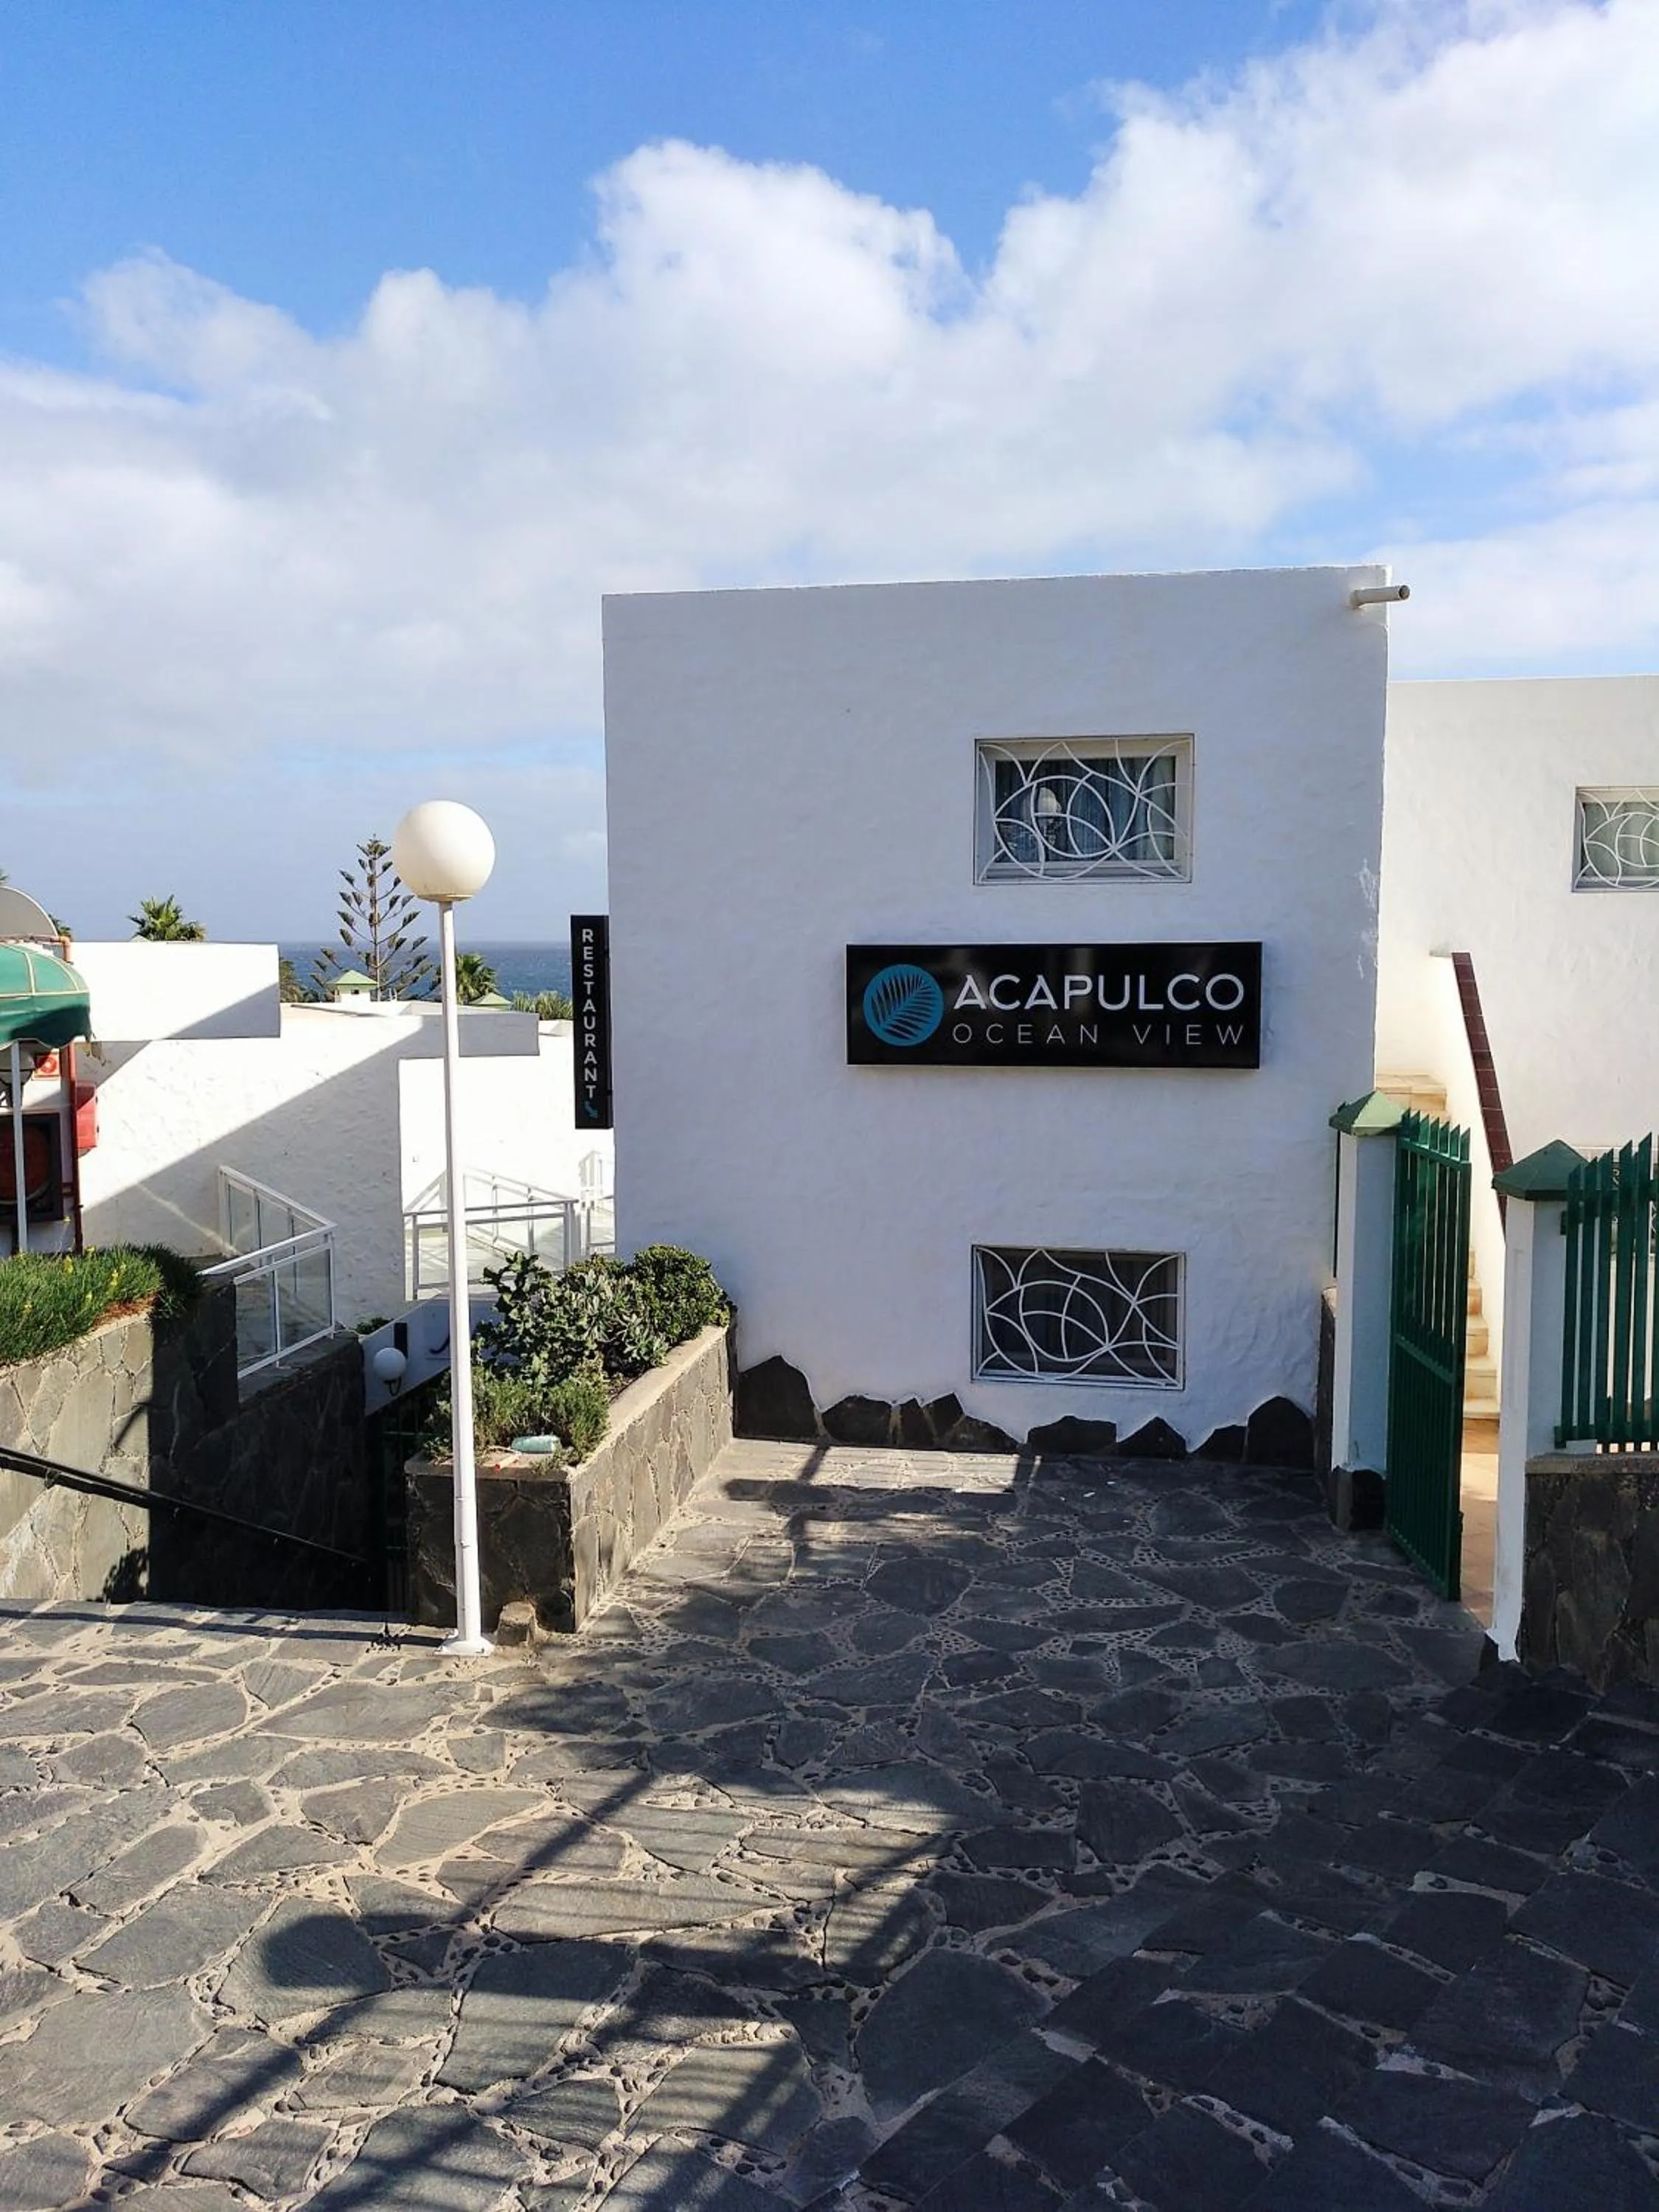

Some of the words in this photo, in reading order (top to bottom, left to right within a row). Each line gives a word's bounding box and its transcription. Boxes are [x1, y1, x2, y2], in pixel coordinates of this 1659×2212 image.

[953, 973, 1245, 1011] ACAPULCO
[582, 928, 598, 1098] RESTAURANT
[953, 1023, 1099, 1045] OCEAN
[1133, 1024, 1244, 1045] VIEW
